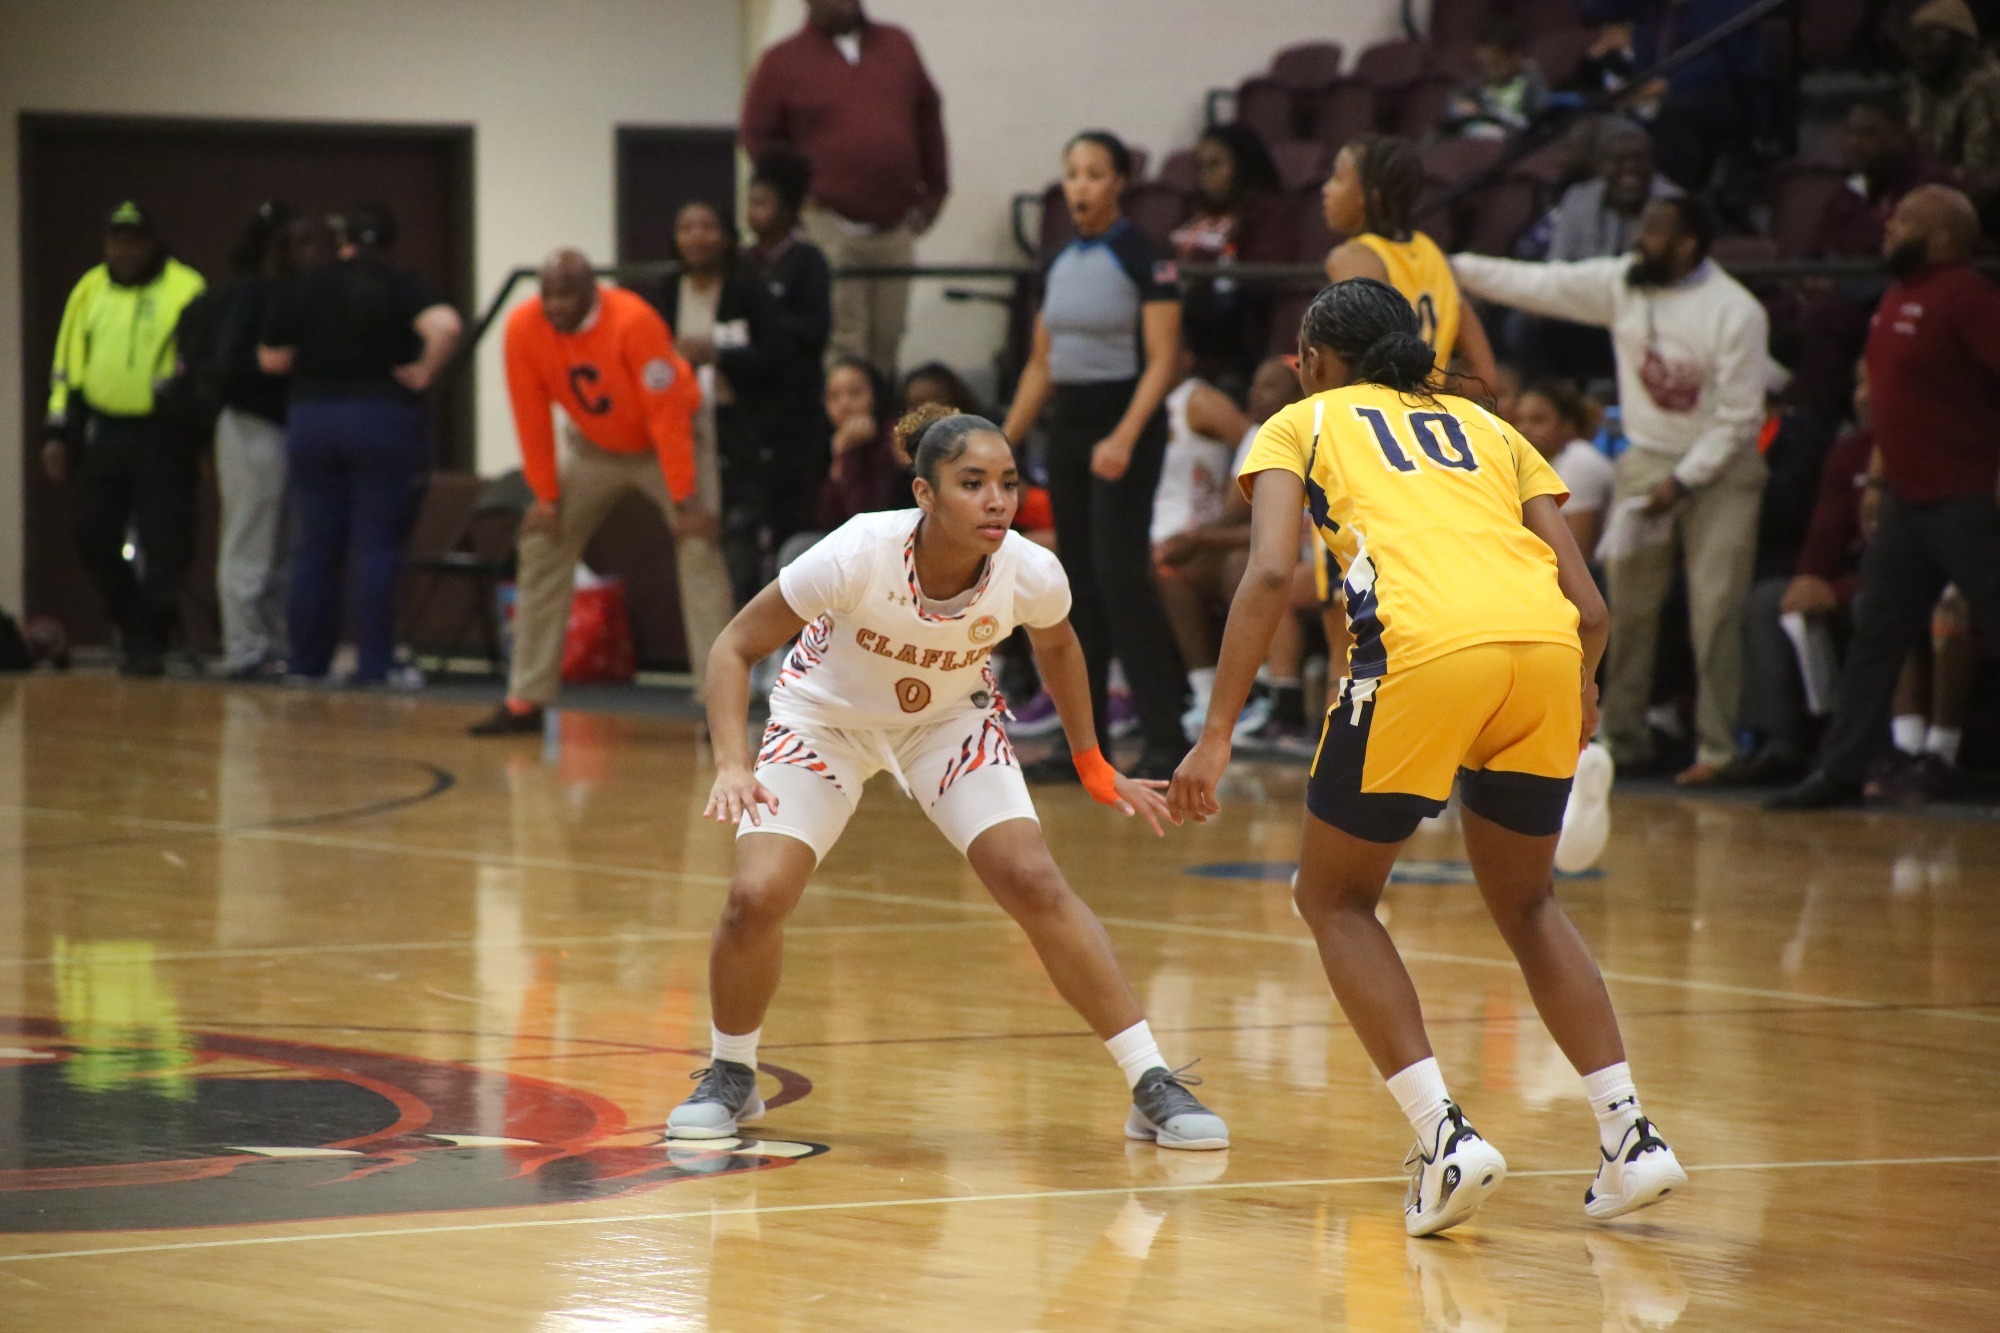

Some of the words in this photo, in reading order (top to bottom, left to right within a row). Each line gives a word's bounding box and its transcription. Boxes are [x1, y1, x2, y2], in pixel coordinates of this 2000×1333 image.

[569, 363, 611, 416] C
[1350, 405, 1482, 476] 10
[974, 624, 993, 638] 50
[894, 677, 932, 713] 0
